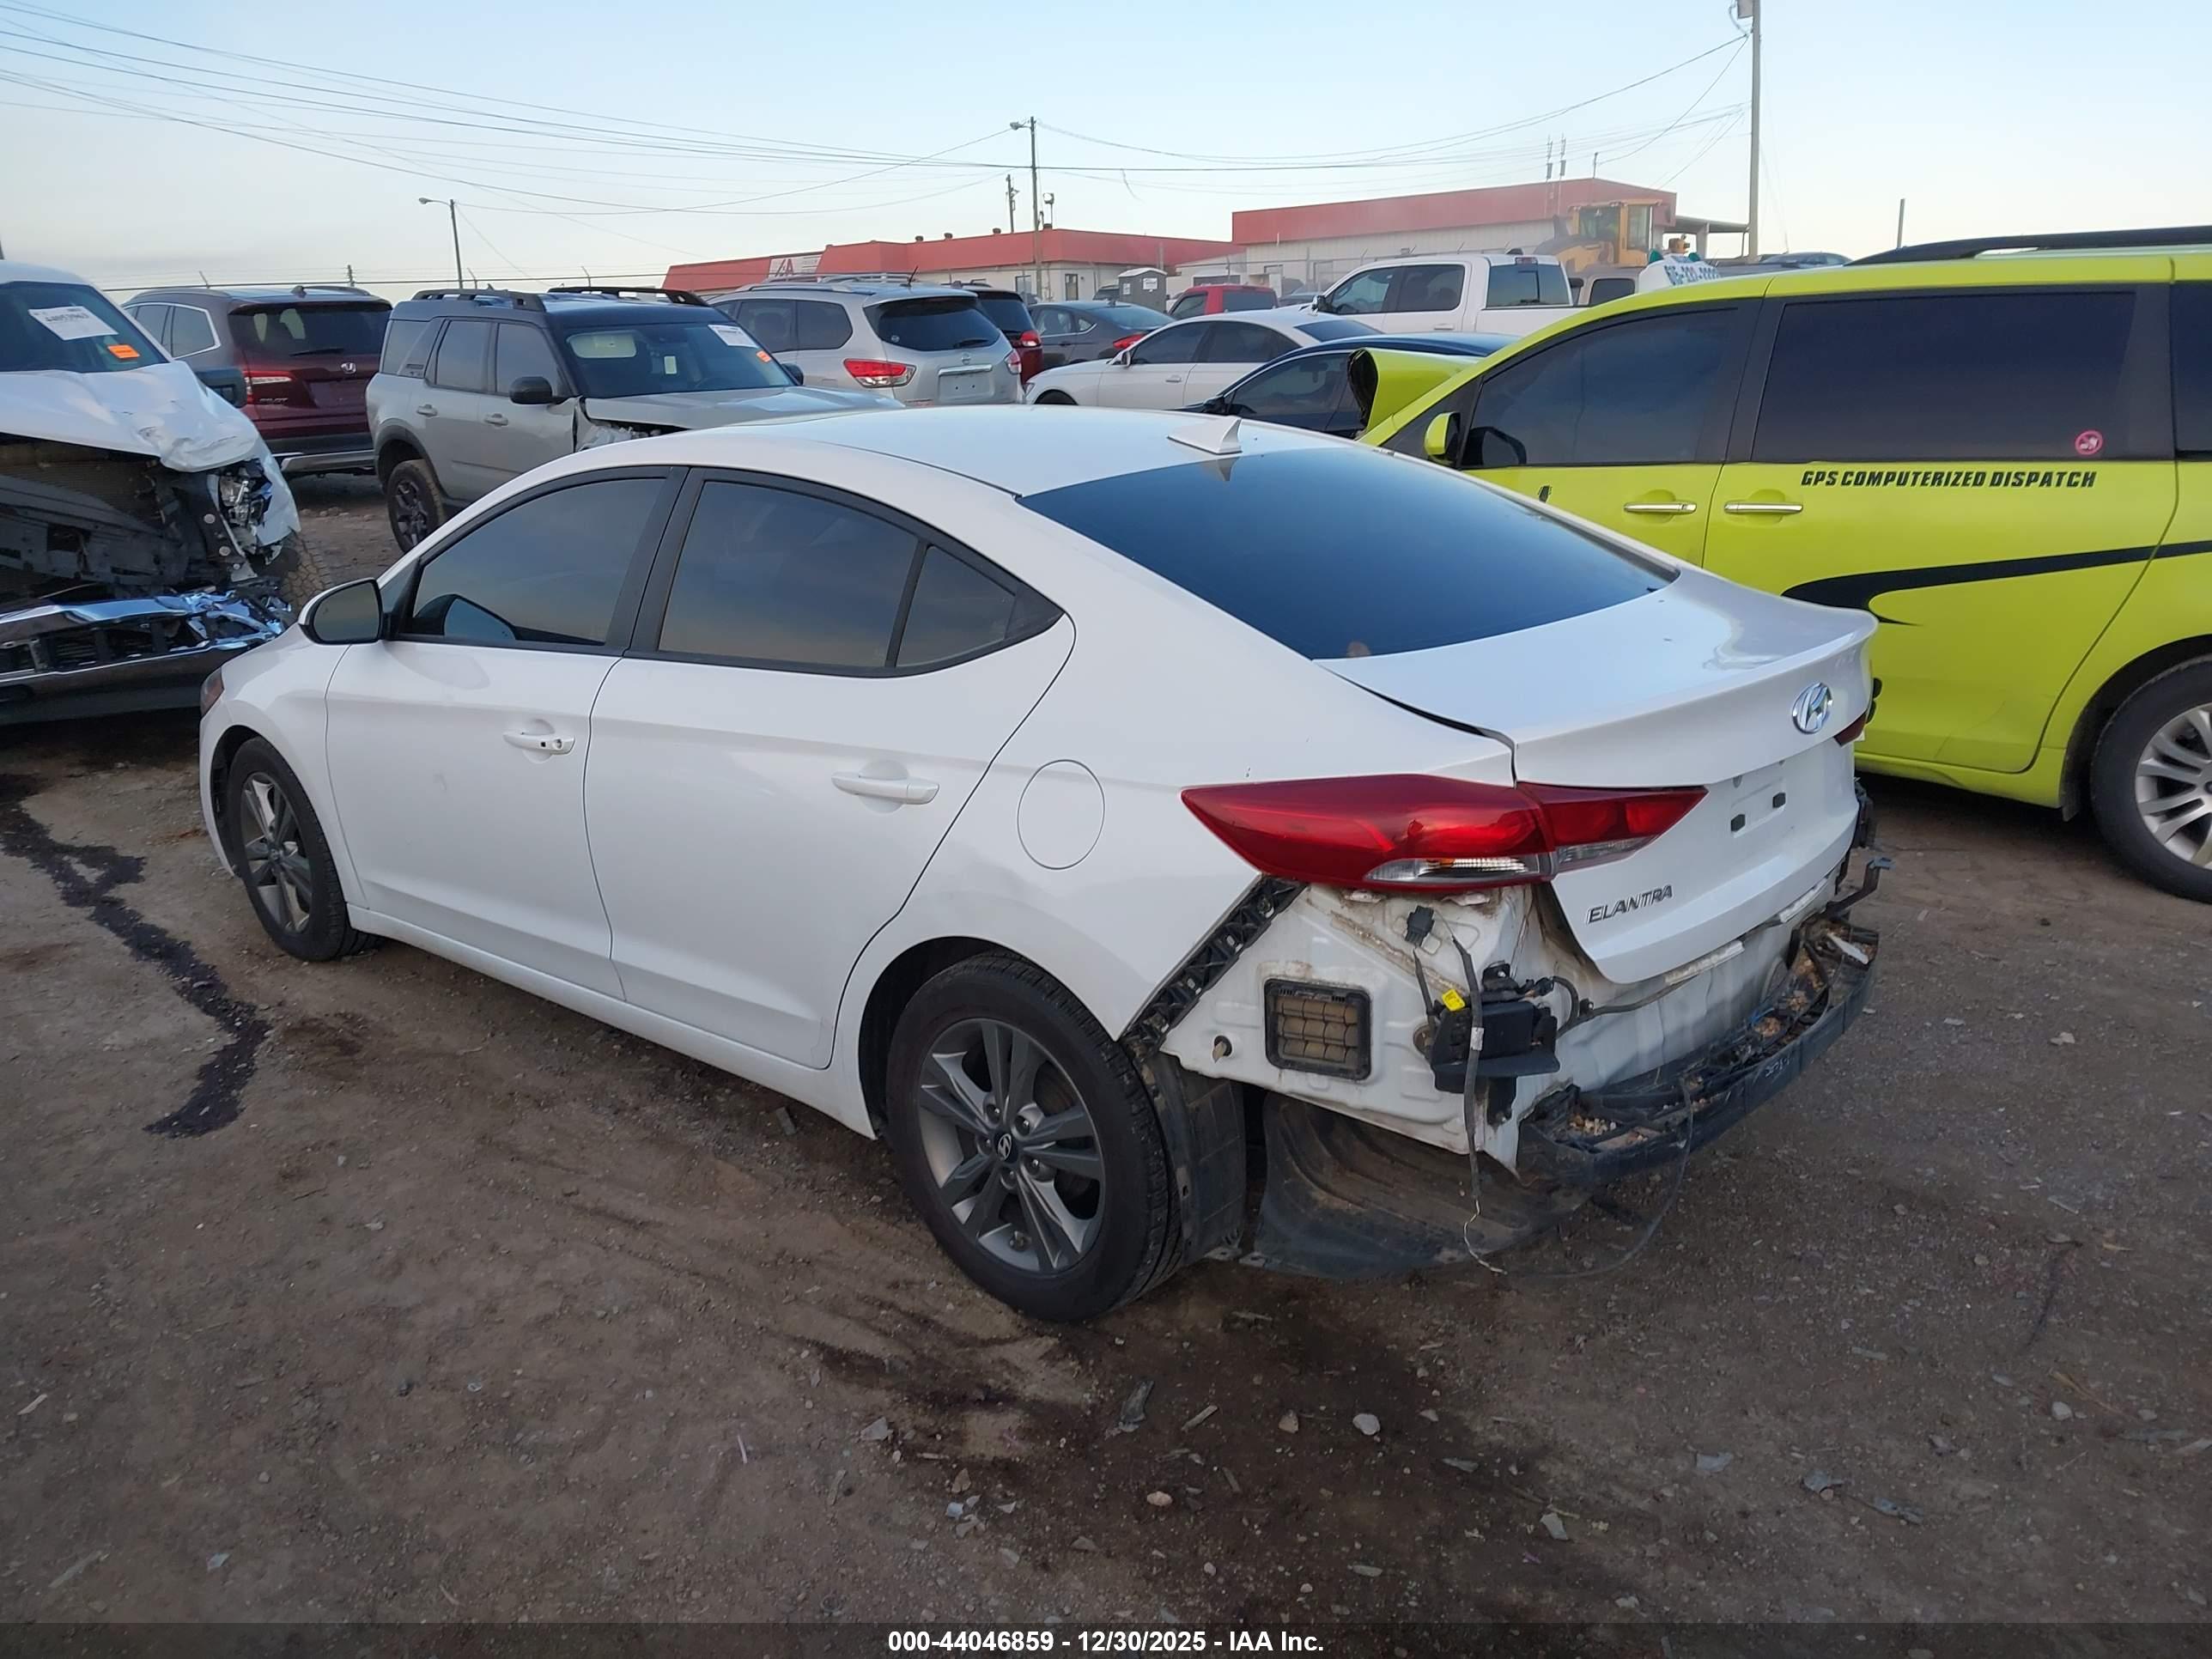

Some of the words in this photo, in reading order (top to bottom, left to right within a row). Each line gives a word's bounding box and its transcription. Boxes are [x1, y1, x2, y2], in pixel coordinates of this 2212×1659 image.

[1801, 471, 1838, 487] GPS
[1841, 471, 1986, 488] COMPUTERIZED
[1989, 471, 2097, 488] DISPATCH
[1586, 884, 1673, 924] ELANTRA
